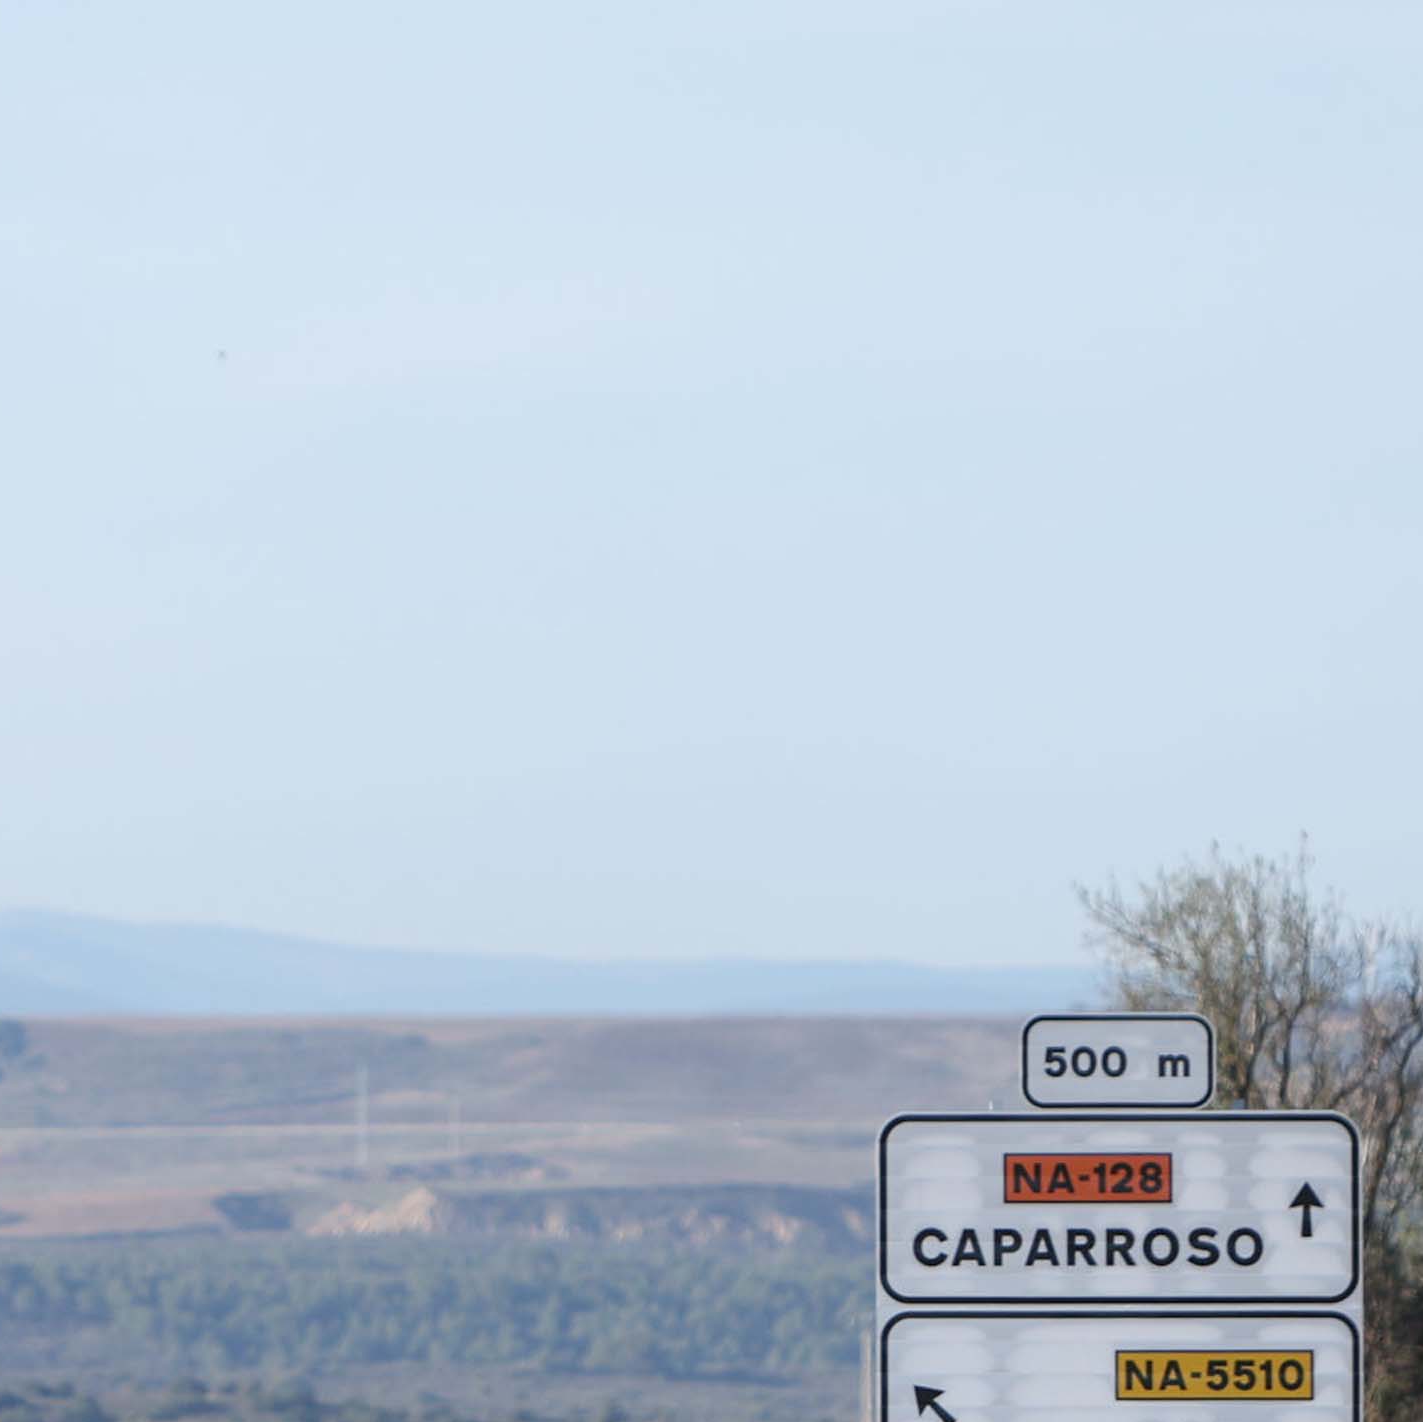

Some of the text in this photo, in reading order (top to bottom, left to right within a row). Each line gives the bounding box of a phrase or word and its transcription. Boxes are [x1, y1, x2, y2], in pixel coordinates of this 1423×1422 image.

[1043, 1046, 1191, 1078] 500 m
[1012, 1162, 1163, 1194] NA-128
[912, 1227, 1264, 1267] CAPARROSO
[1123, 1359, 1304, 1392] NA-5510
